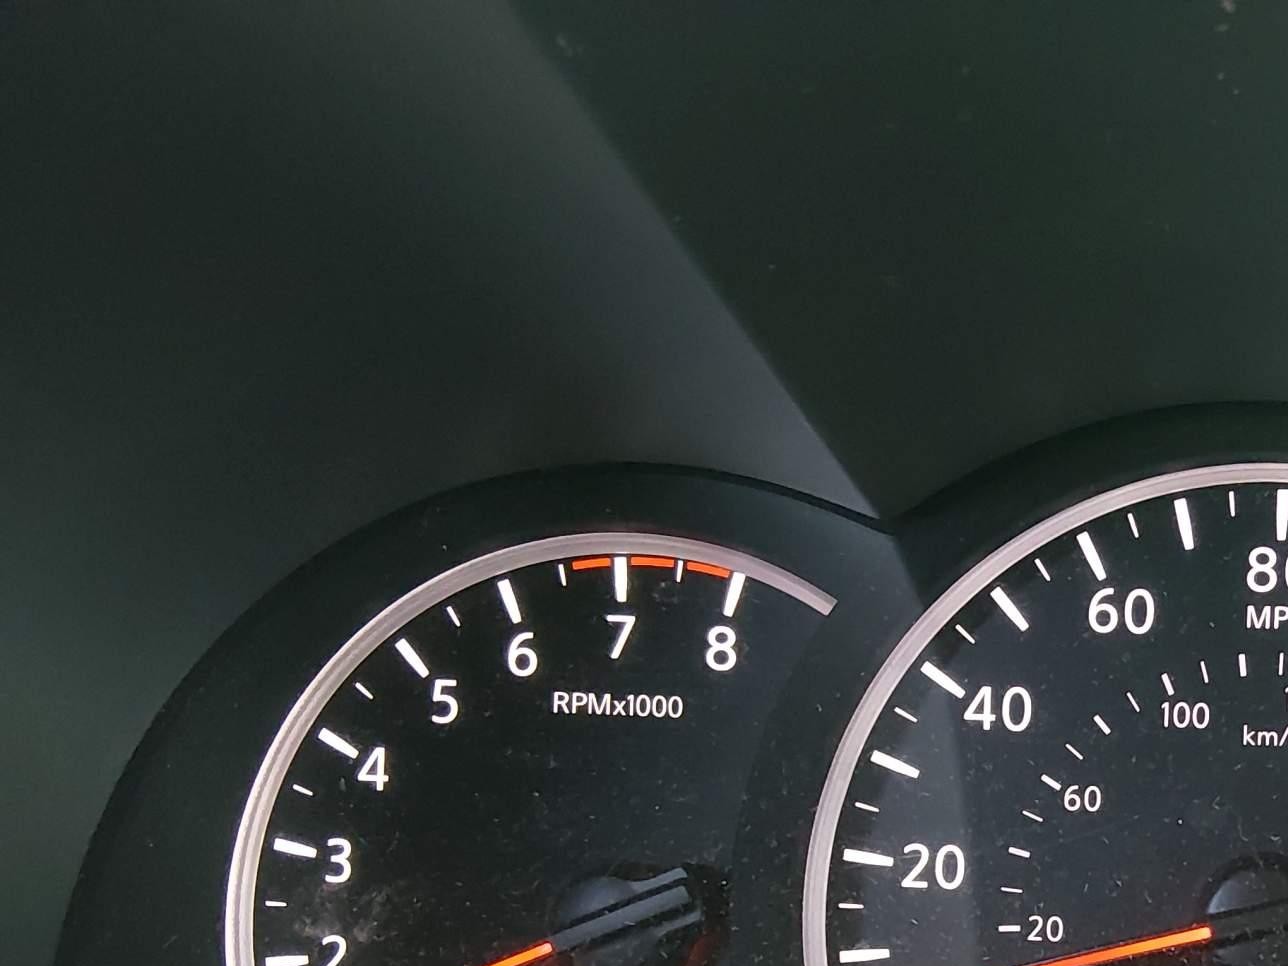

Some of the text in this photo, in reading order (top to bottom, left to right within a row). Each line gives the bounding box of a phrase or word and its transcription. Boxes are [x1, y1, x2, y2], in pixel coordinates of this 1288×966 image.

[1088, 587, 1155, 635] 60
[507, 631, 538, 677] 6
[607, 613, 637, 660] 7
[705, 625, 738, 672] 8
[431, 678, 459, 725] 5
[552, 691, 684, 719] RPMx1000
[964, 685, 1033, 733] 40
[1161, 701, 1210, 730] 100
[356, 745, 390, 792] 4
[1063, 784, 1102, 813] 60
[325, 838, 352, 884] 3
[900, 842, 966, 891] 20
[1026, 914, 1064, 943] 20
